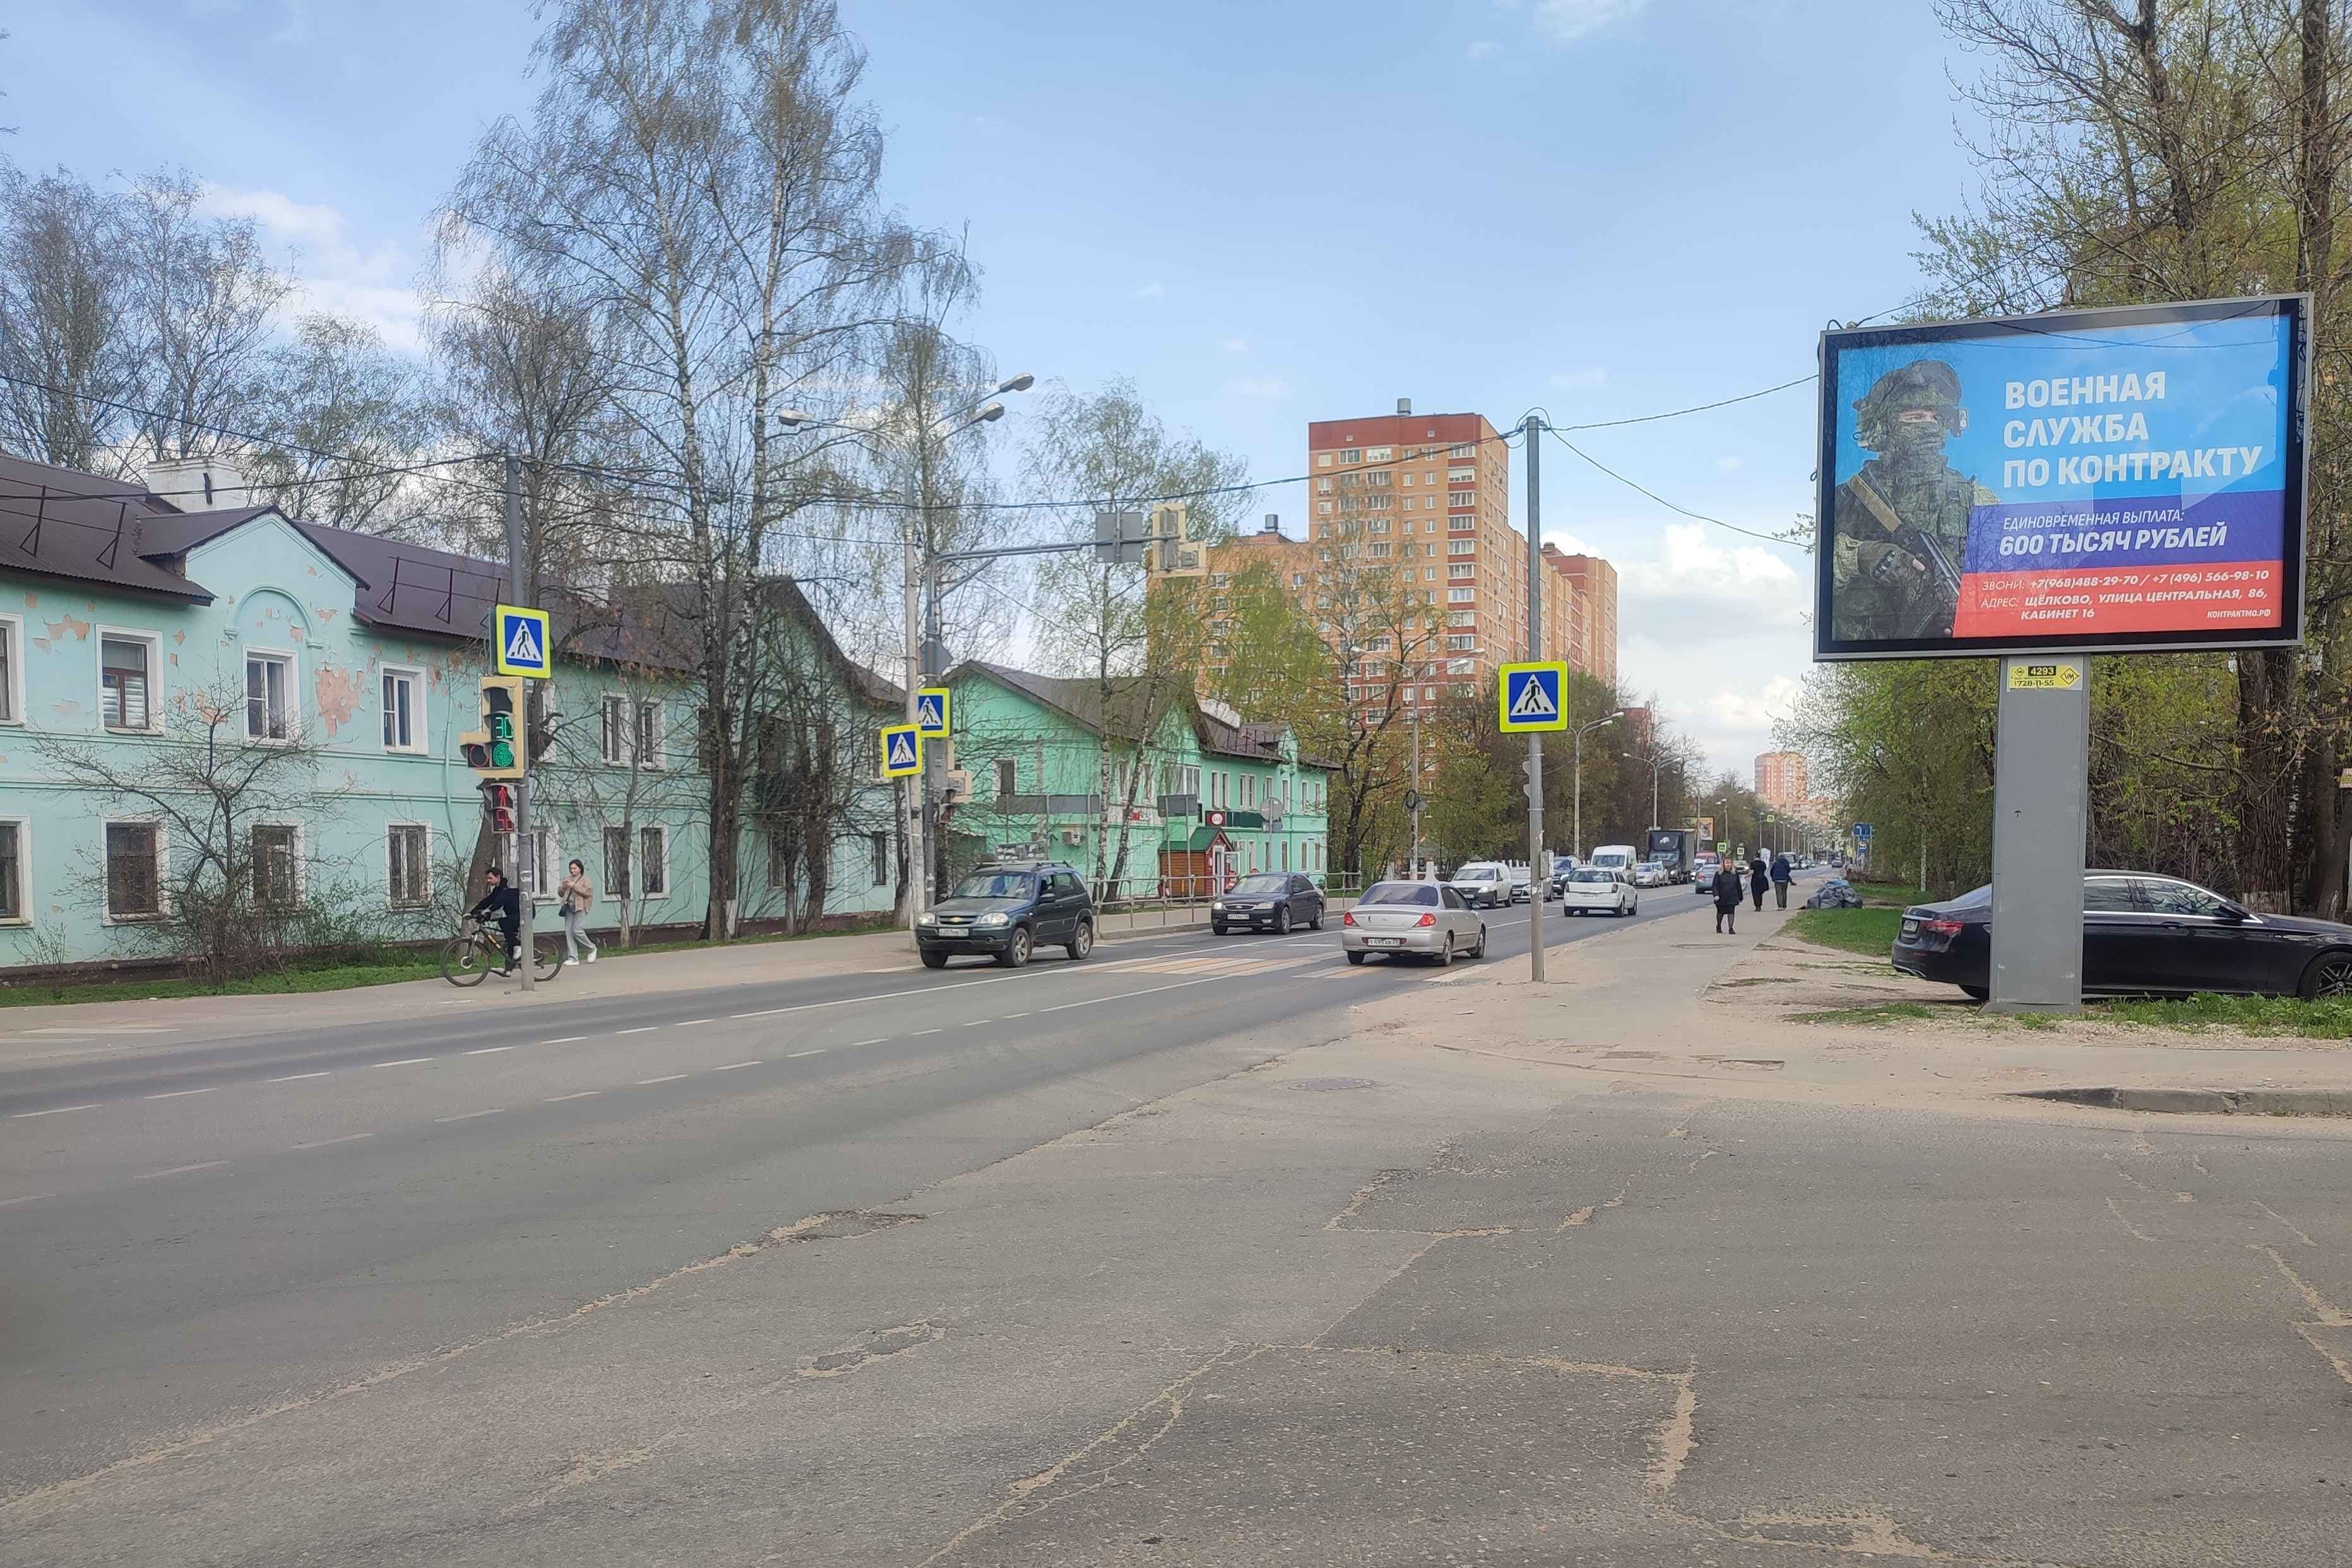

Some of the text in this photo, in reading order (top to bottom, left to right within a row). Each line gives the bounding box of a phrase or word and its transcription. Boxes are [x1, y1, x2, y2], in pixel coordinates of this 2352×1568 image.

[2005, 371, 2166, 410] ВОЕННАЯ
[2004, 412, 2149, 448] СЛУЖБА
[2004, 446, 2263, 488] ПО КОНТРАКТУ
[2003, 509, 2185, 532] ЕДИНОВРЕМЕННАЯ ВЫПЛАТА:
[1999, 521, 2228, 555] 600 ТЫСЯЧ РУБЛЕЙ
[1981, 581, 2024, 591] ЗВОНИ:
[2030, 575, 2139, 589] +7(968)488-29-70
[2152, 574, 2168, 583] +7
[2170, 572, 2202, 585] (496)
[2205, 570, 2270, 582] 566-98-10
[1980, 588, 2268, 609] АДРЕС: ЩЁЛКОВО, УЛИЦА ЦЕНТРАЛЬНАЯ, 86,
[2021, 609, 2095, 620] КАБИНЕТ 16
[2207, 609, 2271, 619] КОНТРАКТМО.РФ
[2030, 667, 2054, 675] 4293
